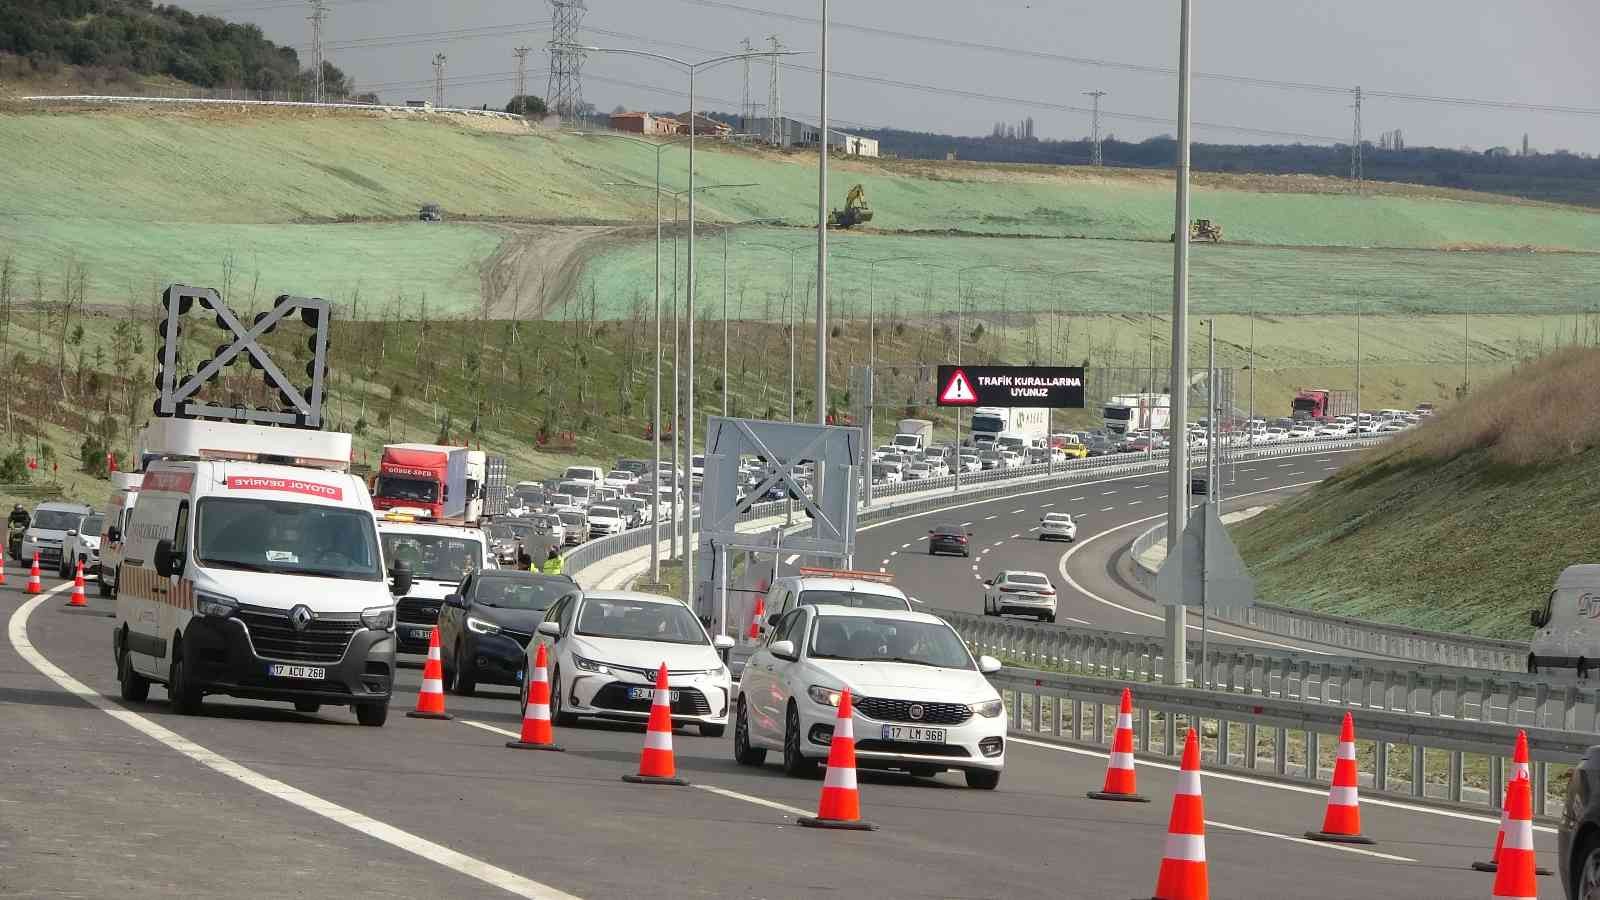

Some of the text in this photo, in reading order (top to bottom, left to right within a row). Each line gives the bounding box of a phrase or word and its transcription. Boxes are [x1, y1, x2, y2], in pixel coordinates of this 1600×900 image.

[977, 375, 1081, 387] TRAFİK KURALLARINA
[1010, 388, 1048, 397] UYUNUZ
[275, 665, 284, 675] 17
[891, 727, 943, 741] 17 LM 968
